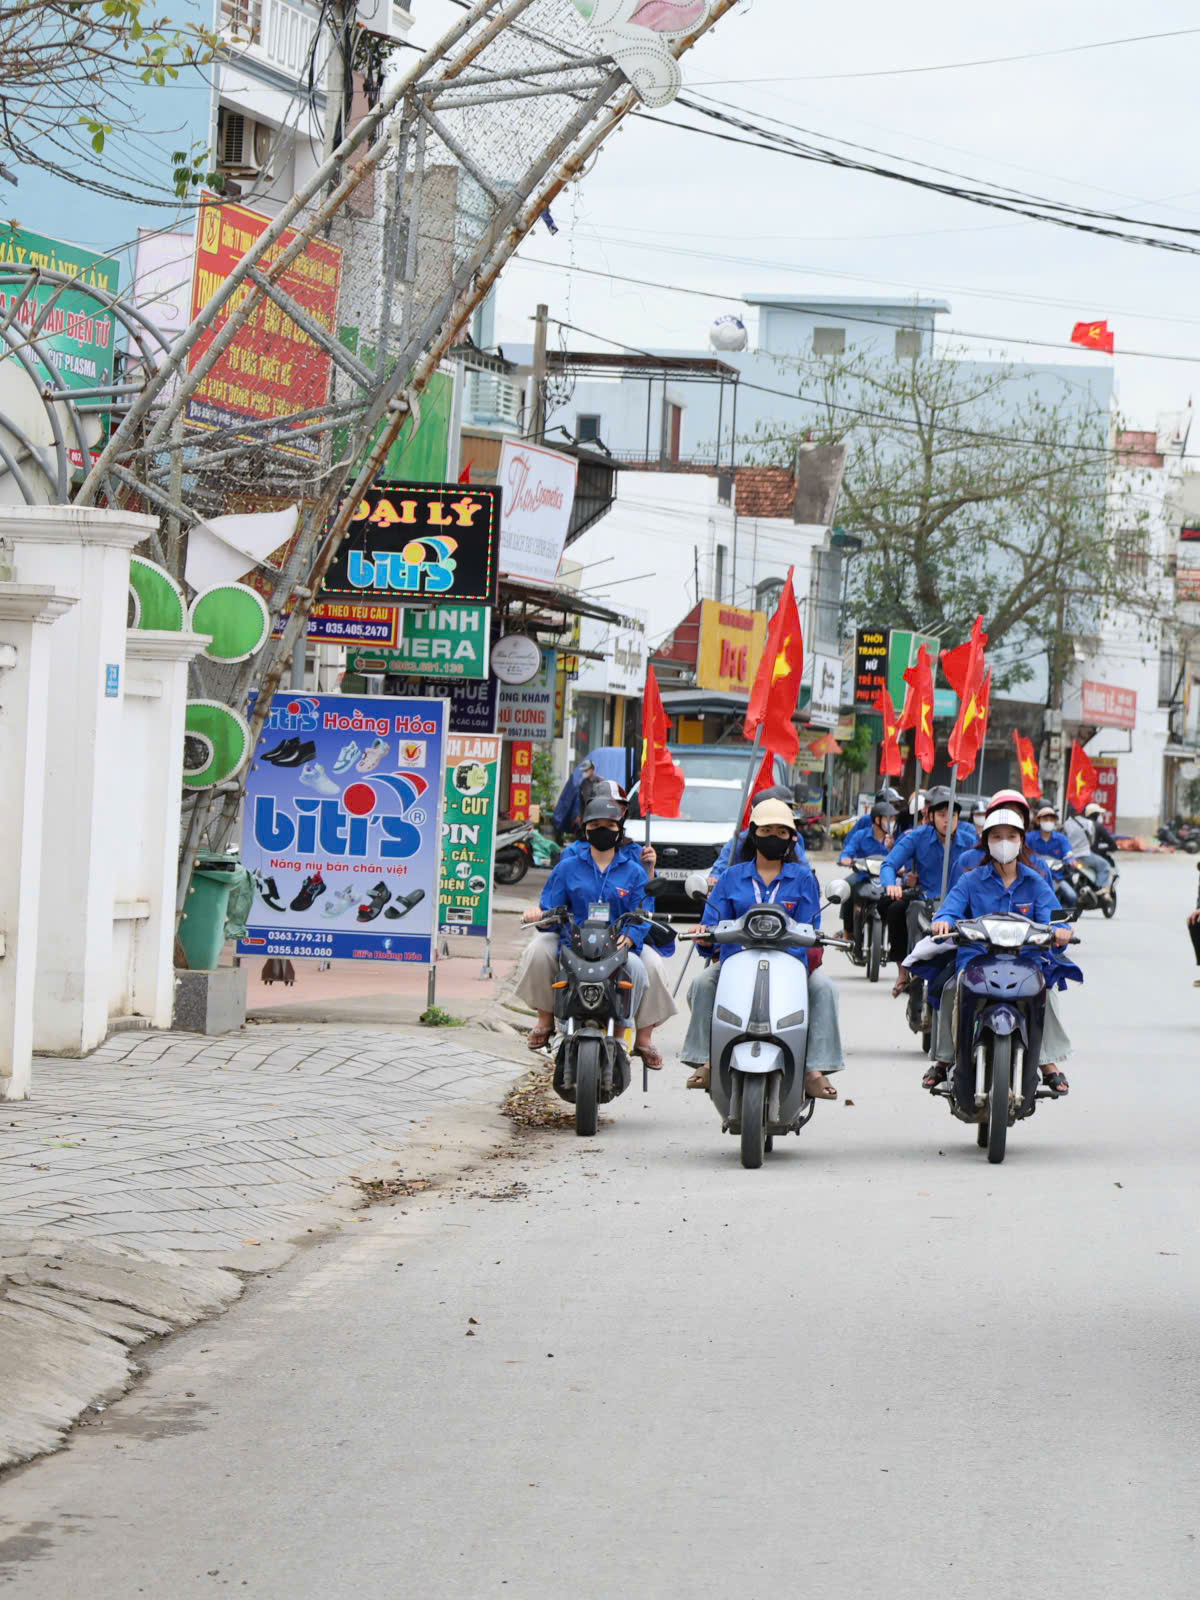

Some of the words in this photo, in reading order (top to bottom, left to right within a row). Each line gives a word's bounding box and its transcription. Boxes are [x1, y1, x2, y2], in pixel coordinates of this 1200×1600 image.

[64, 354, 97, 379] PLASMA
[427, 497, 483, 527] LÝ
[328, 604, 349, 617] THEO
[325, 622, 388, 637] 035.405.2470
[858, 646, 887, 656] TRANG
[865, 658, 878, 670] NỮ
[323, 709, 390, 737] Hoằng
[395, 715, 437, 735] Hóa
[462, 796, 490, 816] CUT
[267, 931, 334, 944] 0363.779.218
[267, 944, 333, 957] 0355.830.080
